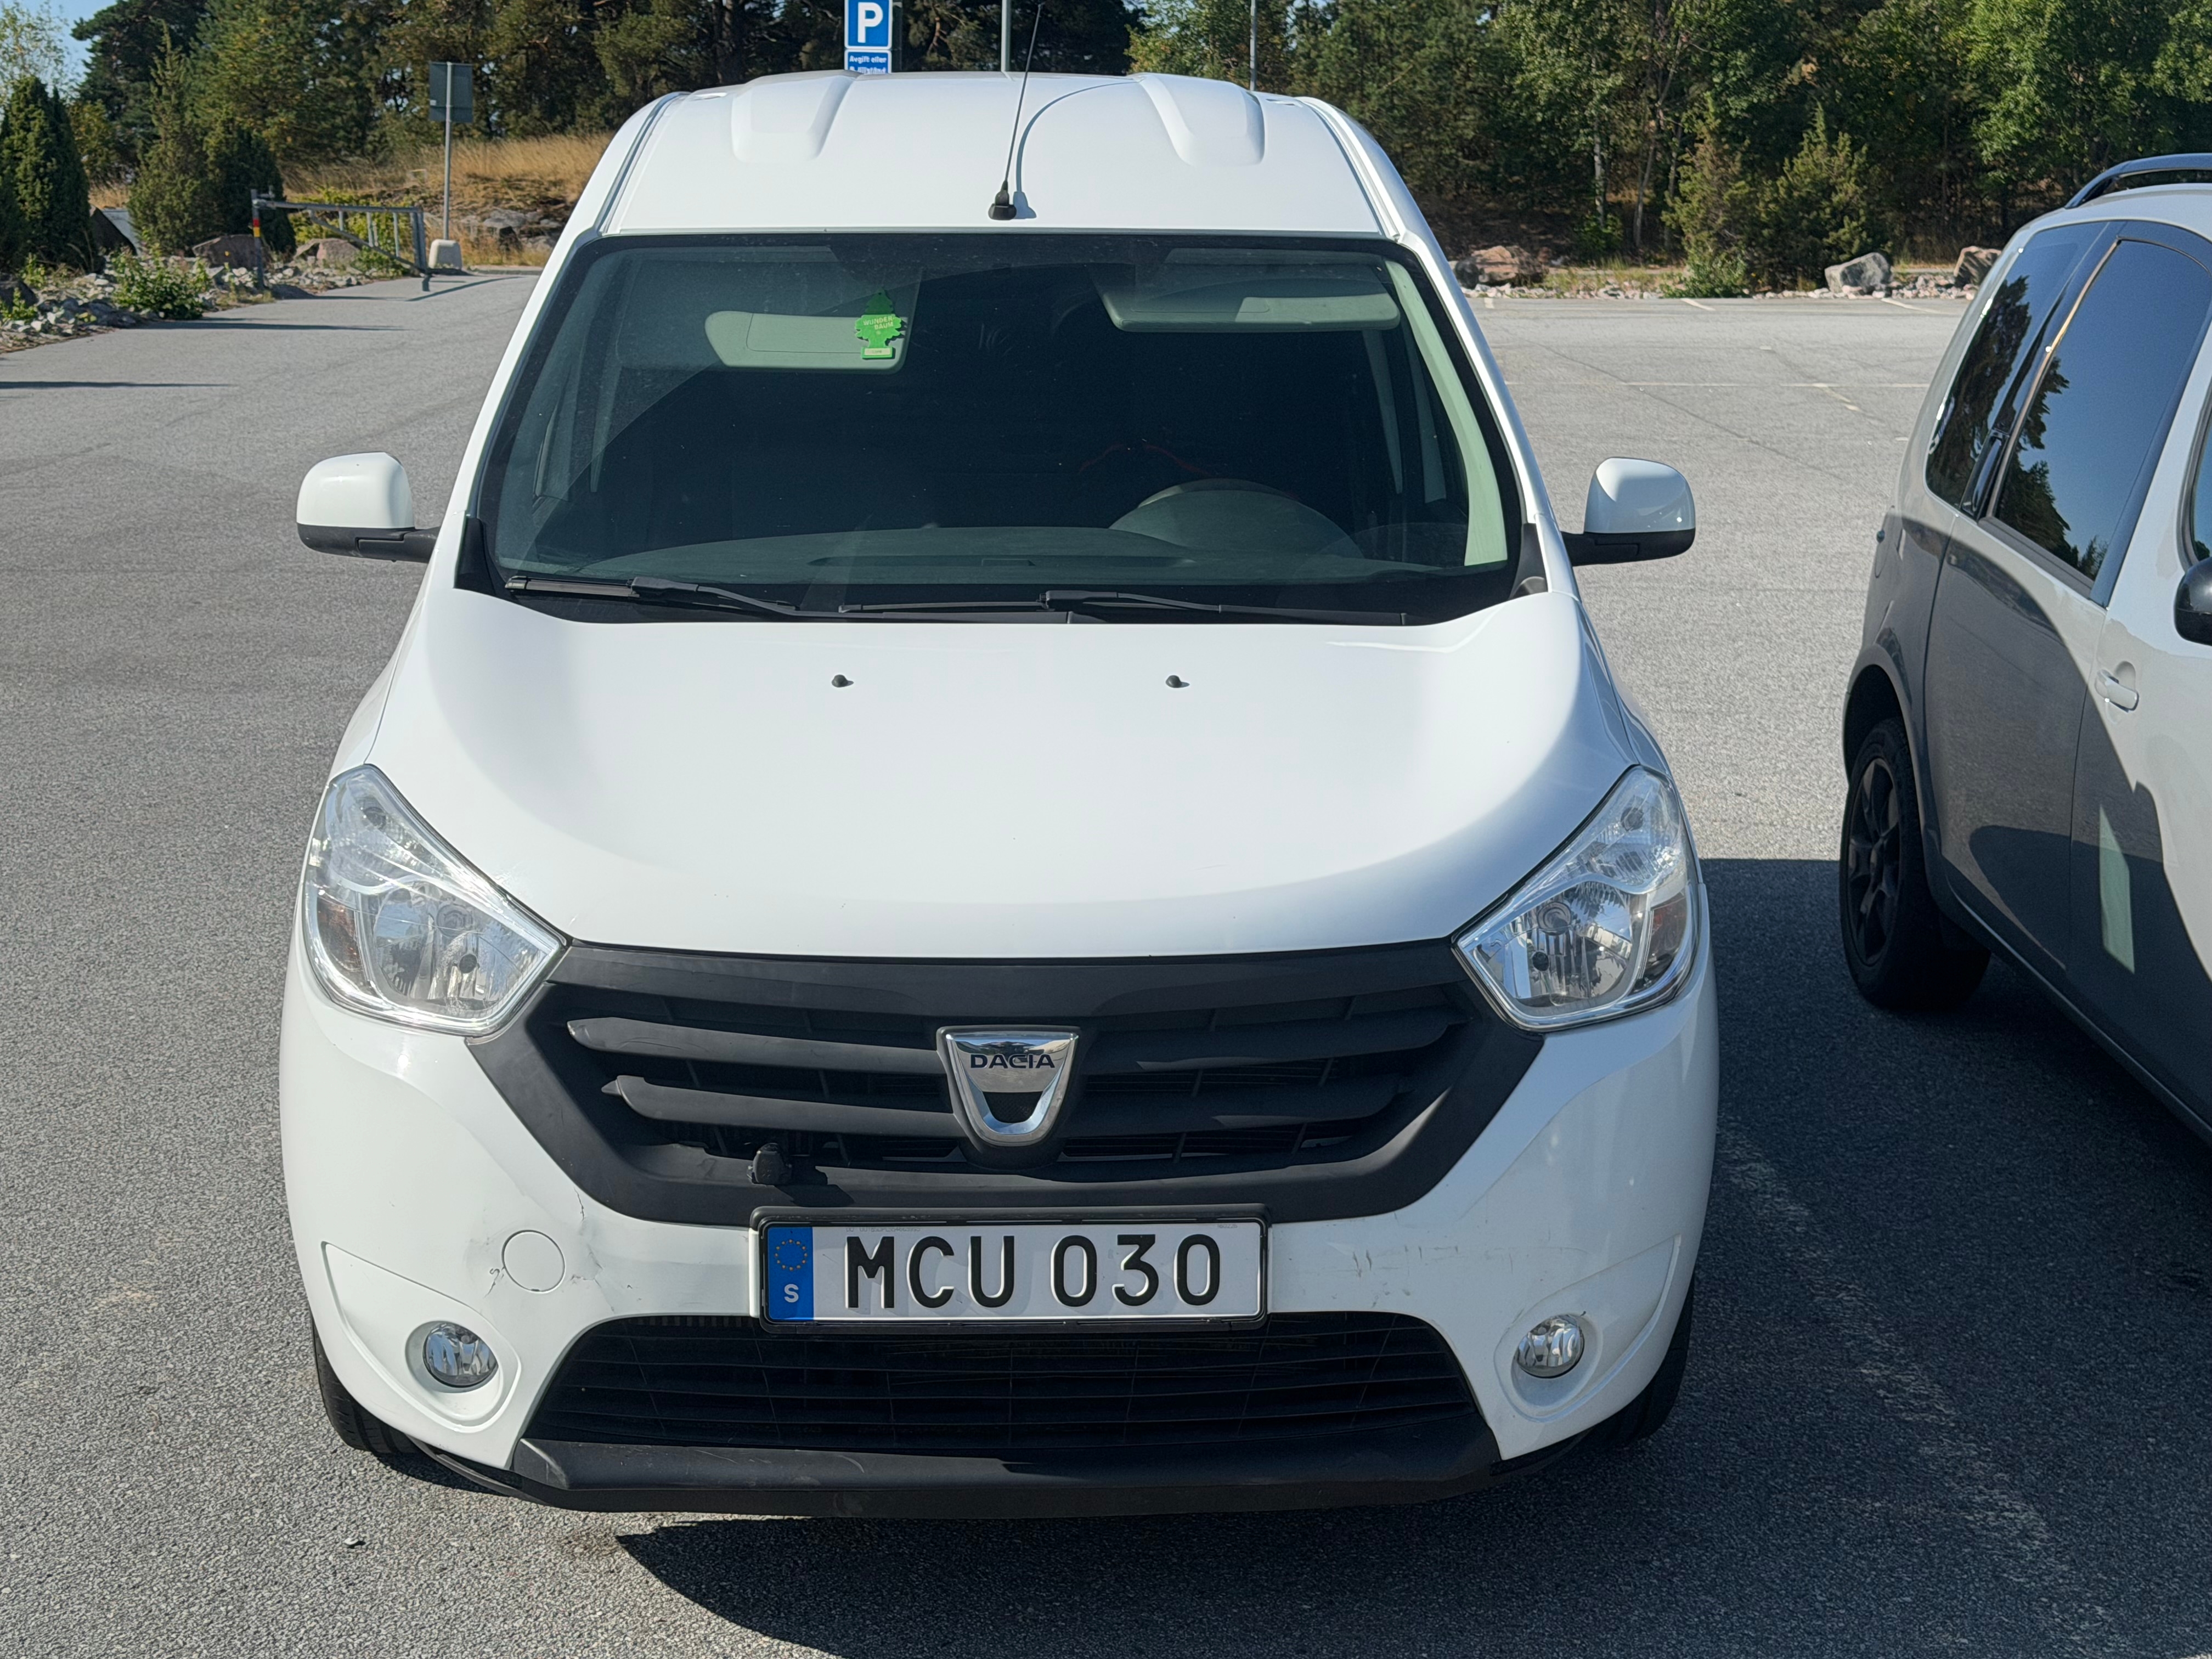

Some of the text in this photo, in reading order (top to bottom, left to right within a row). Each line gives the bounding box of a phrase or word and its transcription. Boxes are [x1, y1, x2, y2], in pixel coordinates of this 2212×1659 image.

[857, 2, 883, 43] P
[849, 55, 870, 64] Avgift
[874, 321, 894, 330] BAUM
[970, 1053, 1056, 1069] DACIA
[846, 1233, 1221, 1309] MCU 030
[784, 1284, 799, 1303] S
